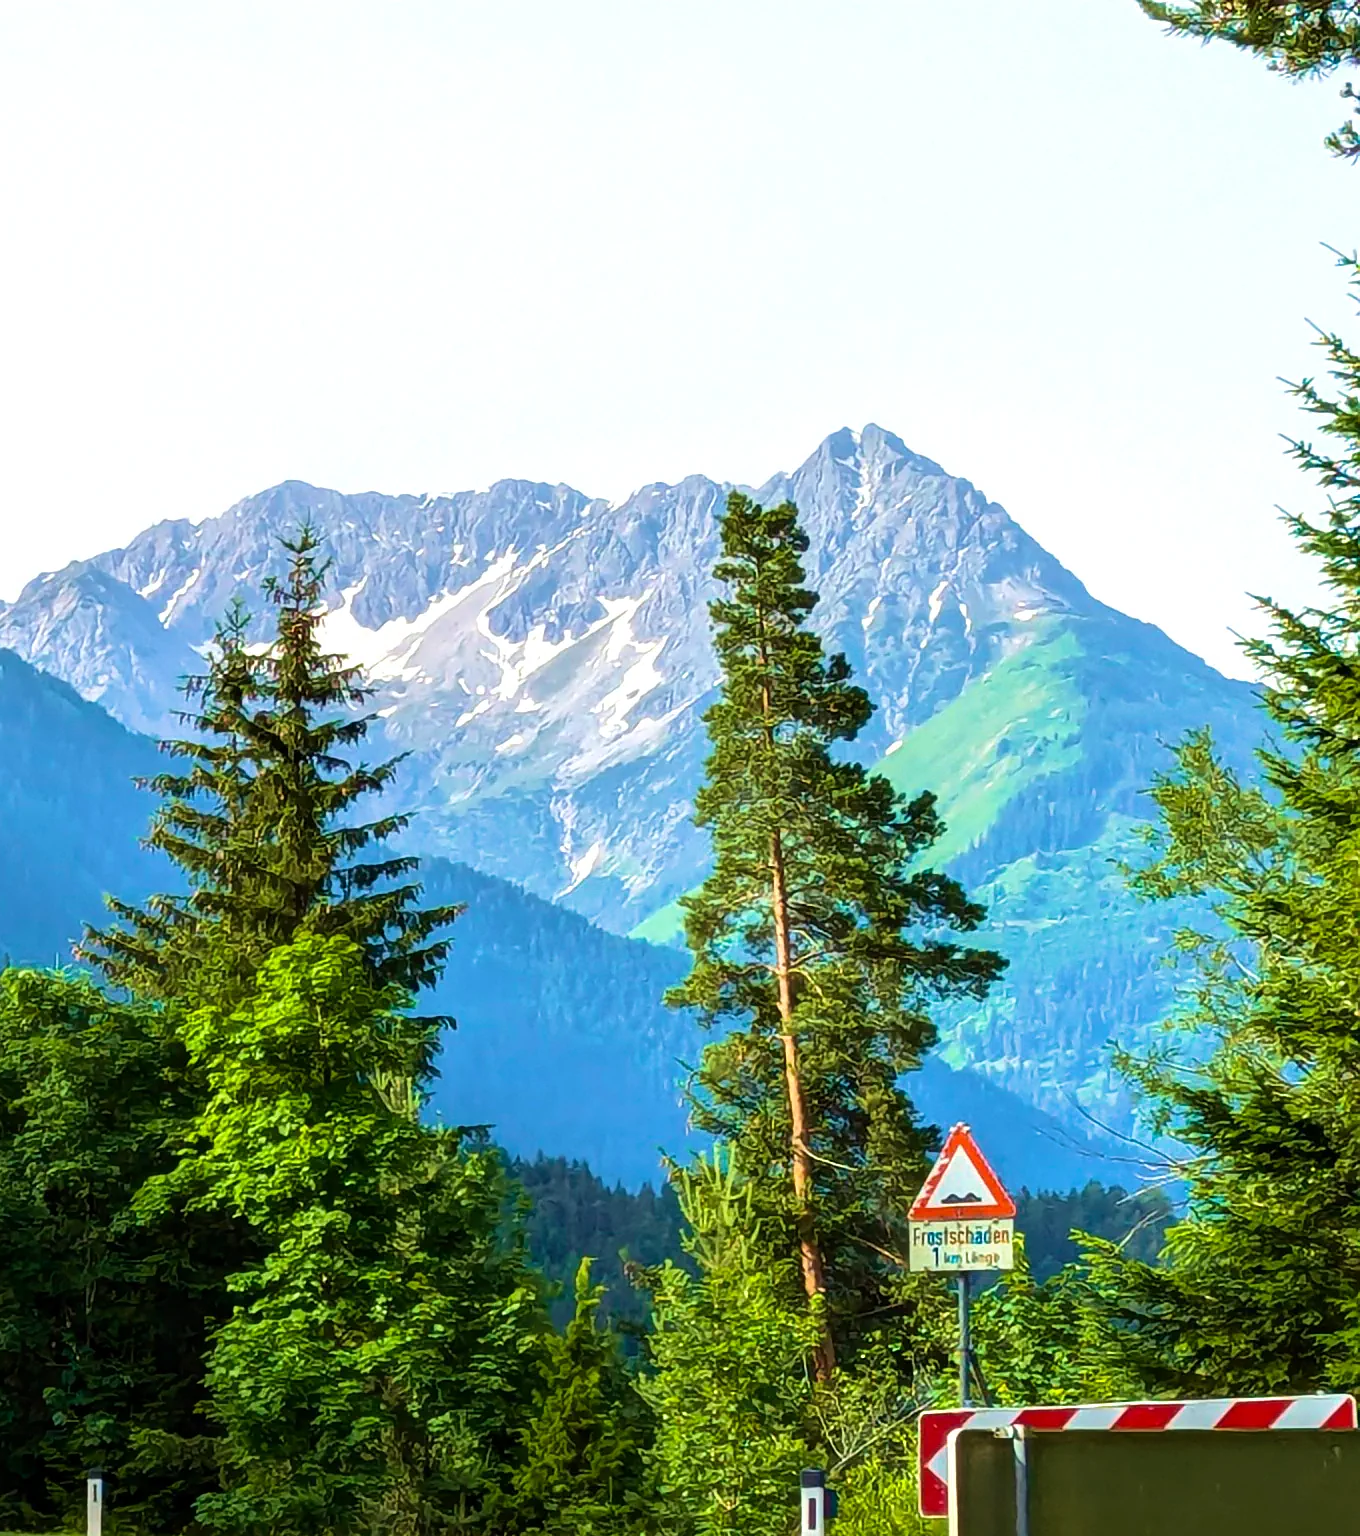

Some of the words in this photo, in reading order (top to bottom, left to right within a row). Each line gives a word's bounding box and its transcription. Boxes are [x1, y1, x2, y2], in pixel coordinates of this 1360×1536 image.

[913, 1225, 1009, 1246] Frostschäden
[932, 1247, 939, 1267] 1
[944, 1252, 962, 1264] km
[965, 1251, 1000, 1267] Länge
